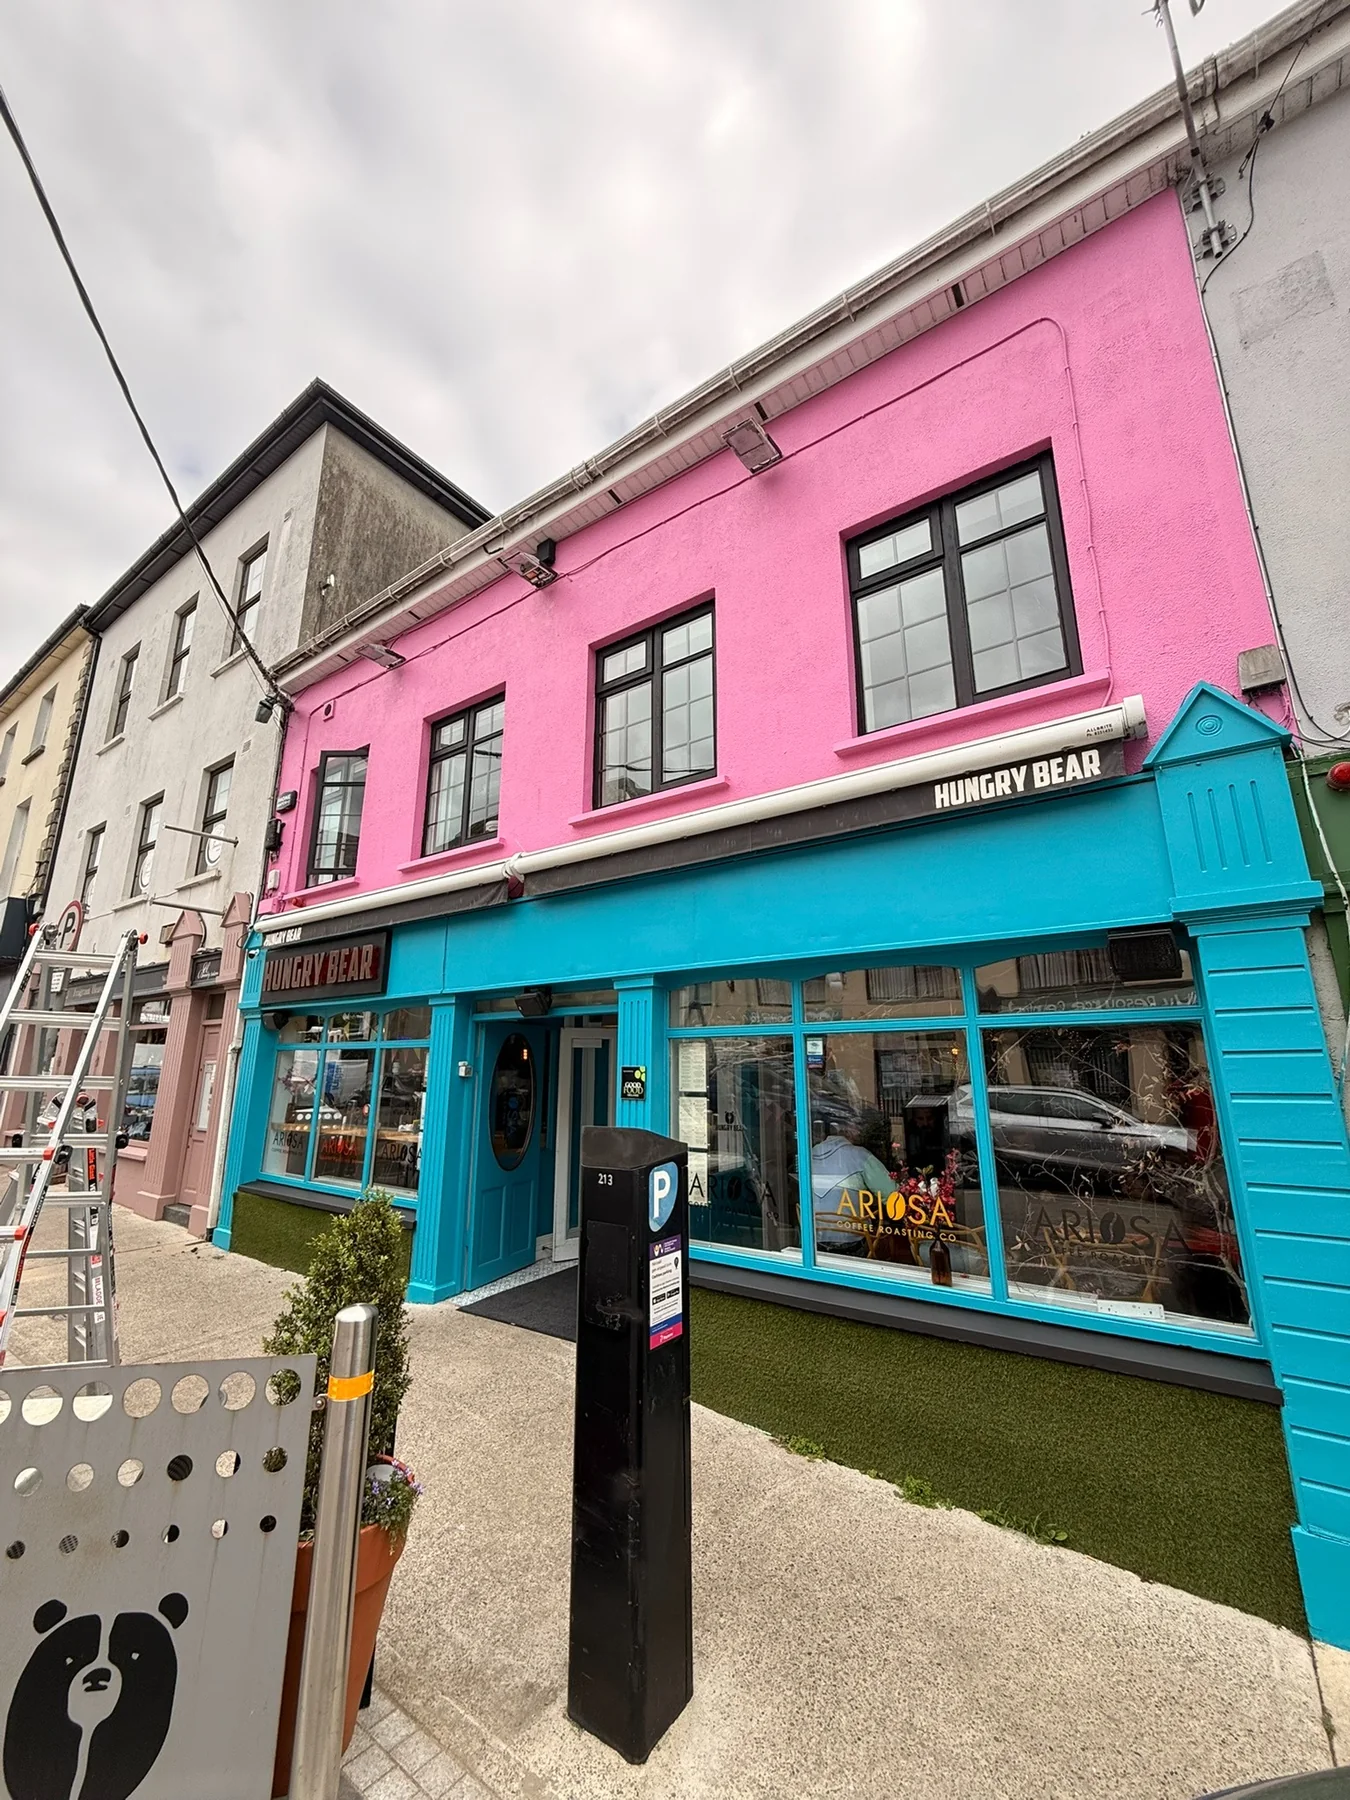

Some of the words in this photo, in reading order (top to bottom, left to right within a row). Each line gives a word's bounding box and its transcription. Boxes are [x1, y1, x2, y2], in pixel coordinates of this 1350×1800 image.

[934, 764, 1027, 809] HUNGRY
[1032, 749, 1101, 788] BEAR
[286, 927, 303, 943] BEAR
[263, 952, 326, 992] HUNGRY
[326, 944, 374, 985] BEAR
[623, 1086, 644, 1095] FOOD
[598, 1173, 613, 1186] 213
[653, 1170, 671, 1219] P
[688, 1172, 778, 1207] ARIOSA
[836, 1187, 954, 1229] ARIOSA
[836, 1220, 875, 1233] COFFEE
[1033, 1206, 1194, 1256] ARIOSA
